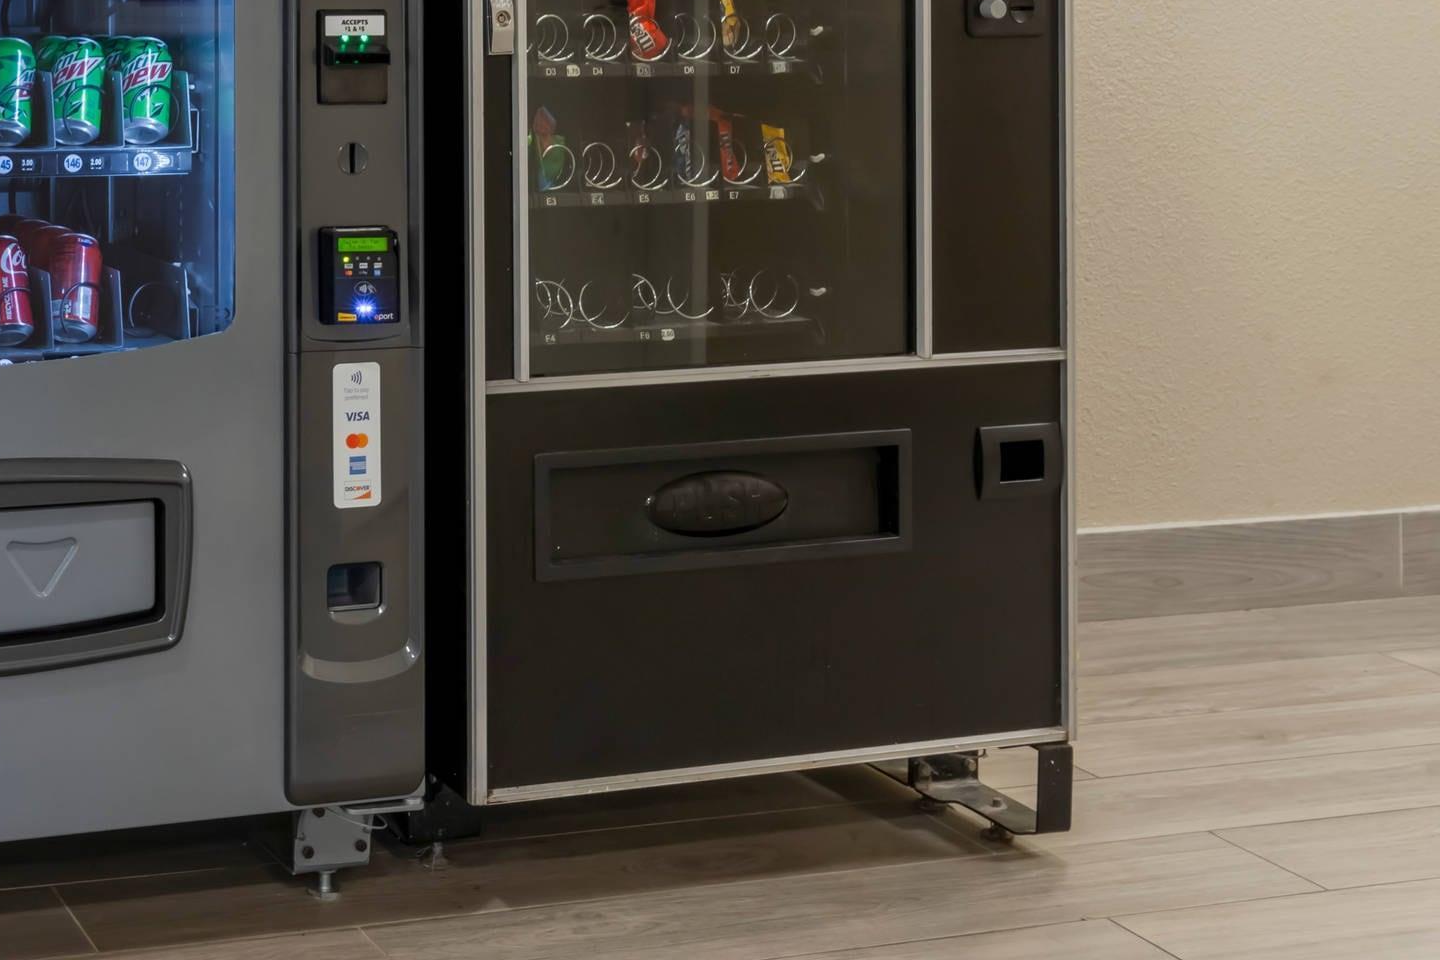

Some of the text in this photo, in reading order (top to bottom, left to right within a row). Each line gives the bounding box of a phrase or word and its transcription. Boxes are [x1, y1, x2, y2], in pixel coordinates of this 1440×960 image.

[545, 67, 557, 77] D3
[592, 67, 603, 76] D4
[683, 66, 695, 75] D6
[730, 65, 740, 75] D7
[65, 158, 81, 169] 146
[134, 156, 150, 167] 147
[591, 195, 603, 205] E4
[639, 194, 650, 203] E5
[685, 192, 696, 201] E6
[729, 191, 739, 200] E7
[546, 197, 557, 206] E3
[374, 313, 394, 321] eport
[545, 334, 556, 343] F4
[640, 331, 650, 340] F6
[345, 411, 370, 422] VISA
